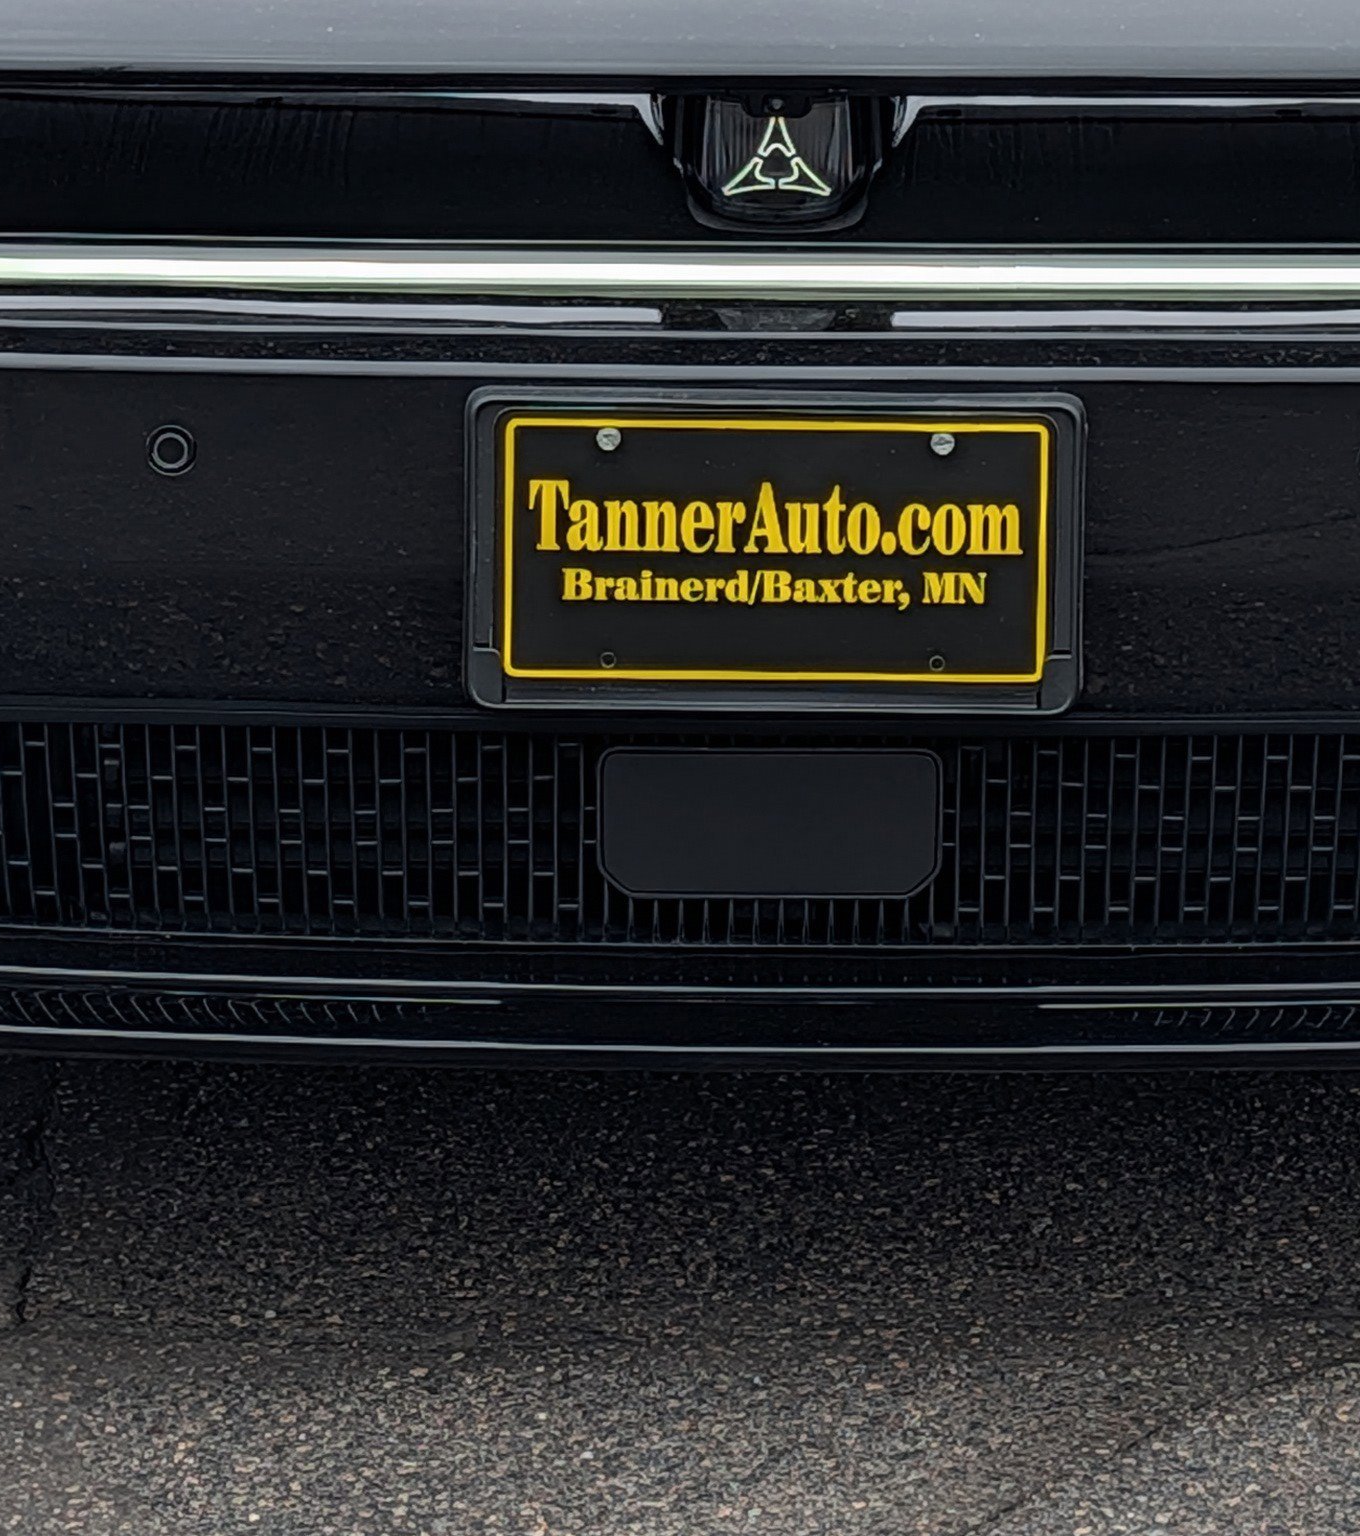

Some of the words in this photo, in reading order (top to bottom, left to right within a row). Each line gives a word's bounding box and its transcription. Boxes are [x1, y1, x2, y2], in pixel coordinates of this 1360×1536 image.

[529, 478, 1023, 556] TannerAuto.com
[562, 568, 910, 610] Brainerd/Baxter,
[922, 571, 987, 605] MN
